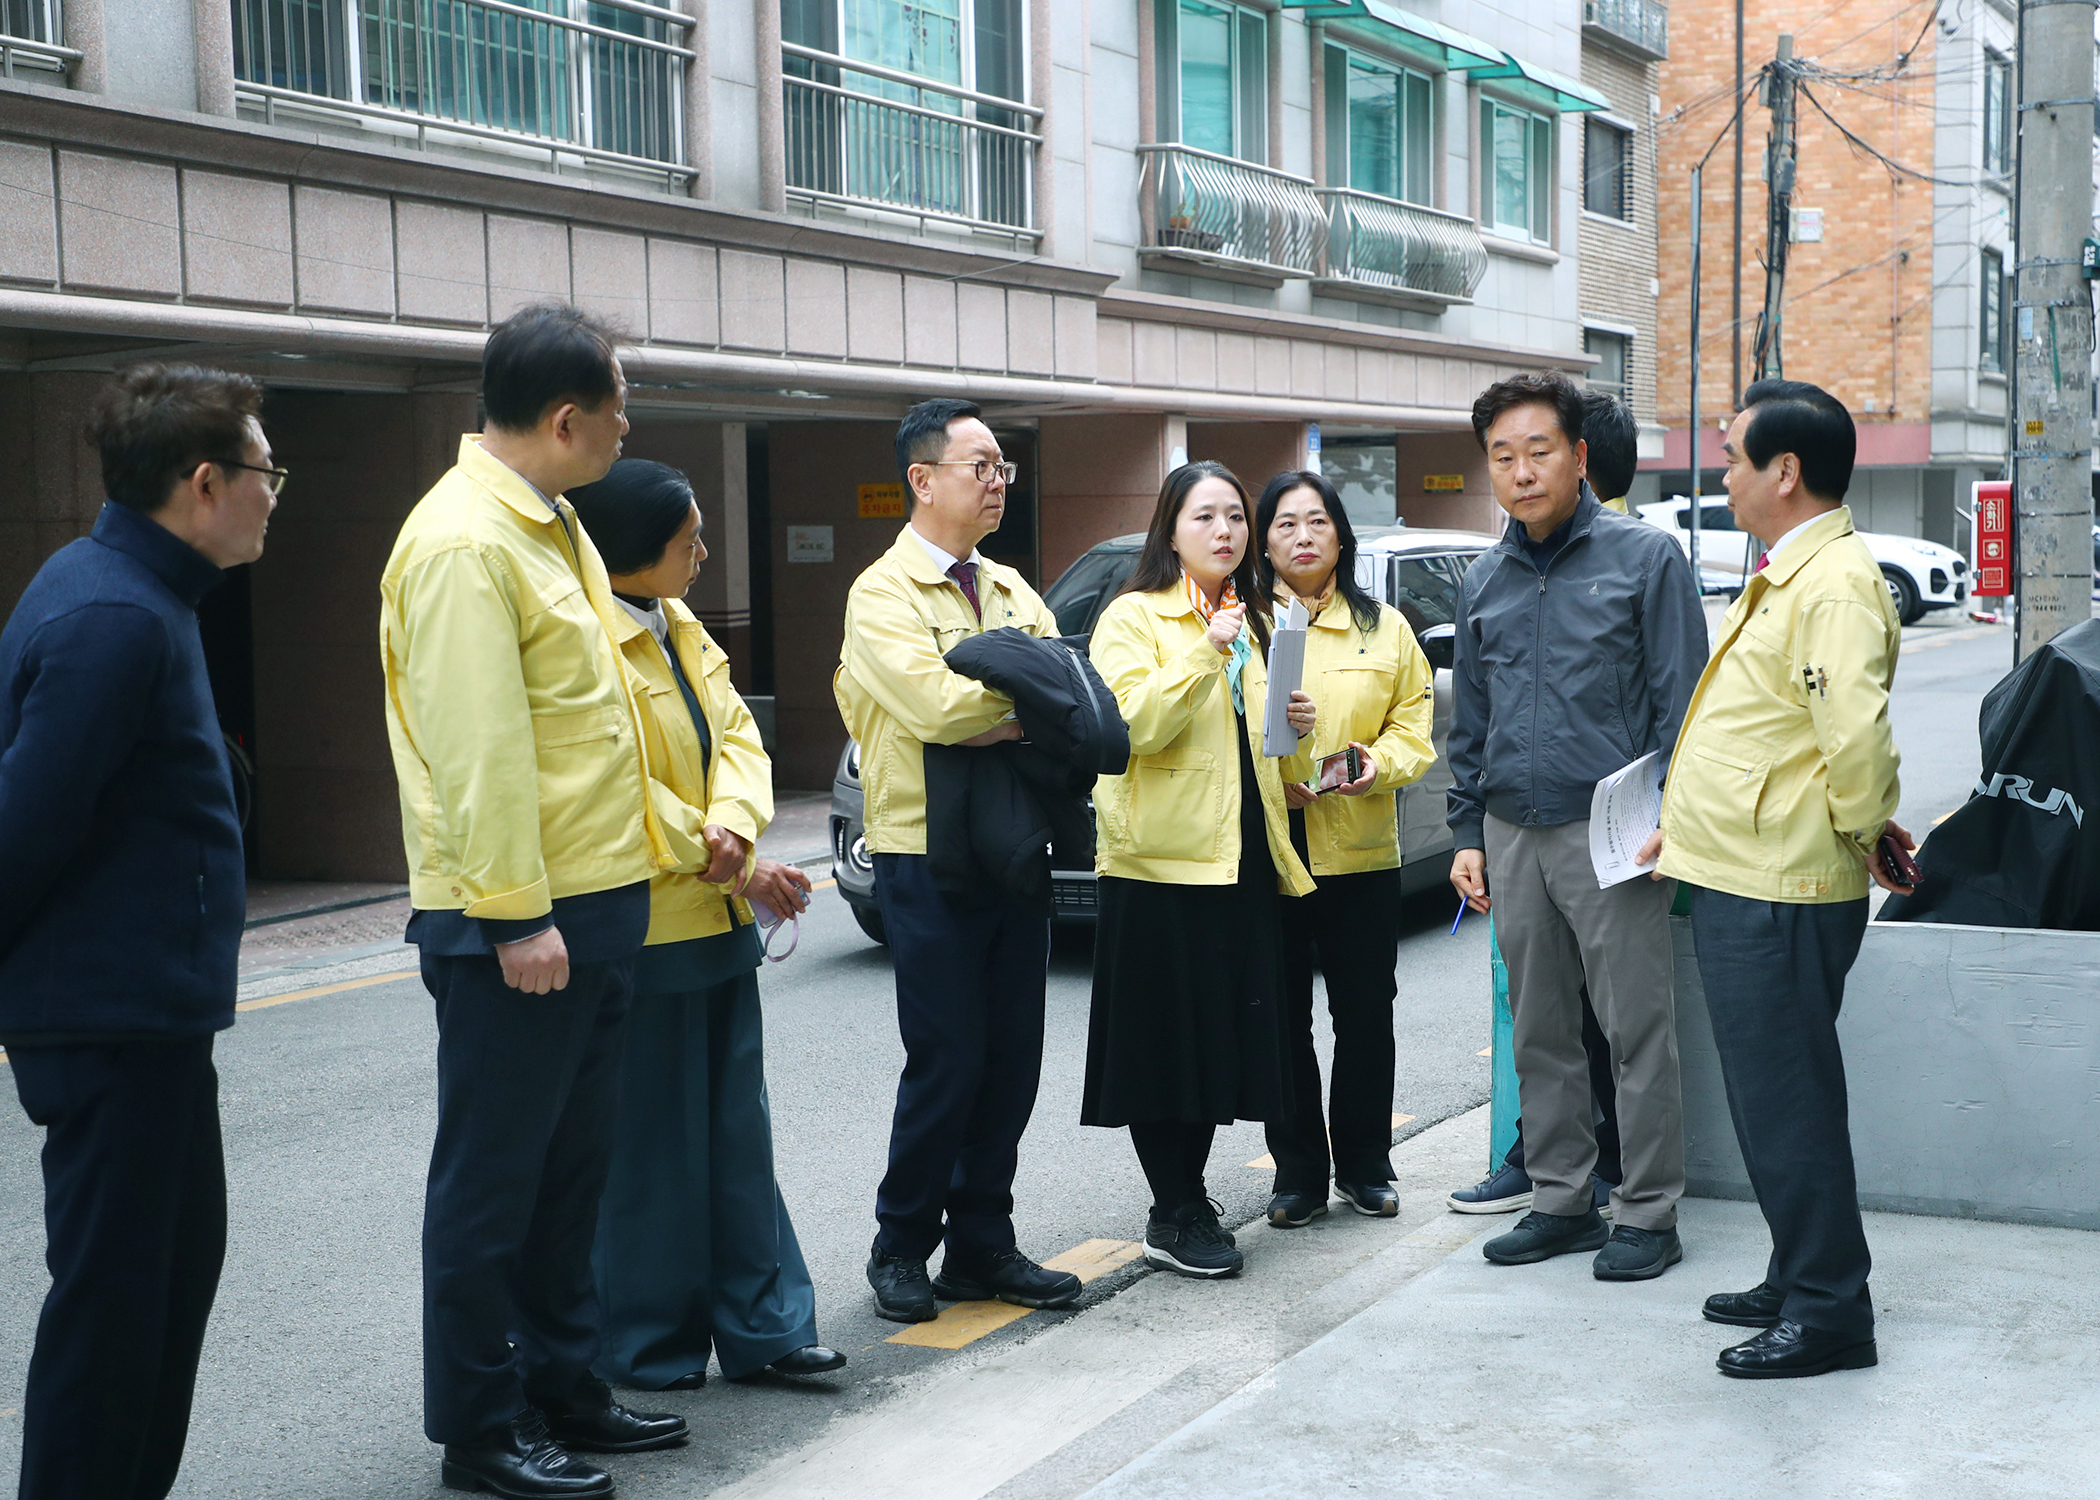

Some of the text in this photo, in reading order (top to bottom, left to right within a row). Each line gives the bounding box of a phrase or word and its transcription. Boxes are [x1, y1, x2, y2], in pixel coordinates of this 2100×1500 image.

[862, 503, 901, 514] 주차금지
[1986, 500, 1996, 530] 소화기
[1975, 771, 2085, 830] RUN
